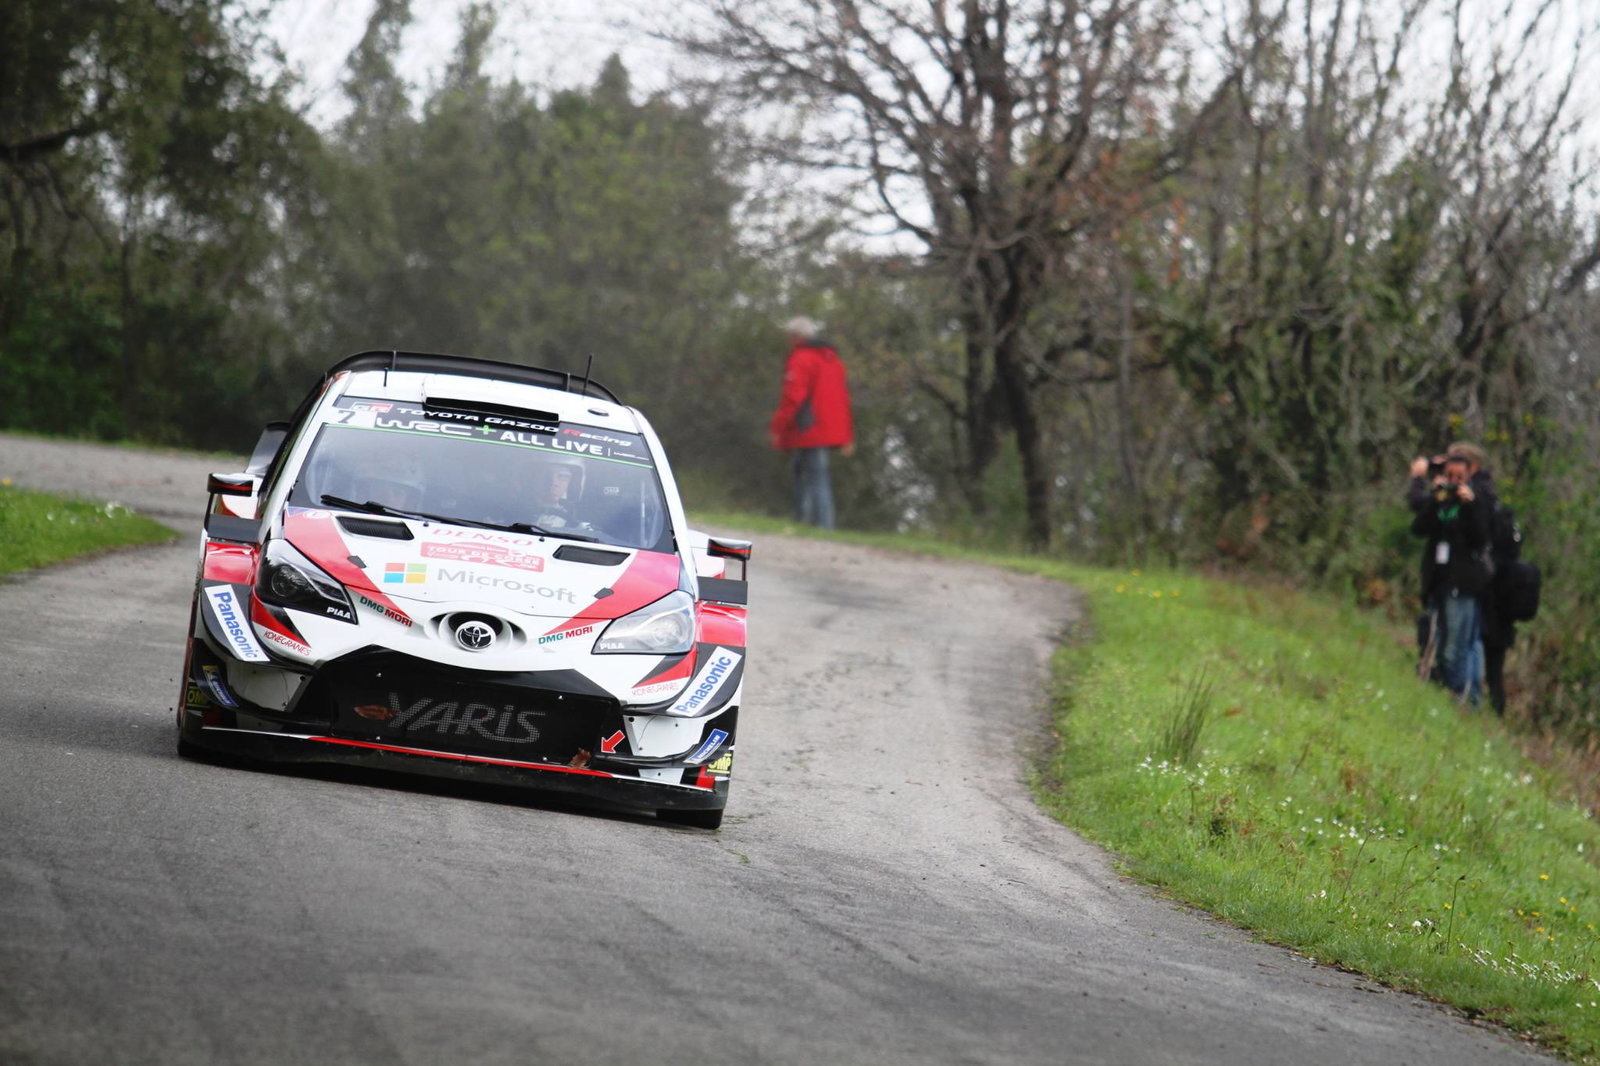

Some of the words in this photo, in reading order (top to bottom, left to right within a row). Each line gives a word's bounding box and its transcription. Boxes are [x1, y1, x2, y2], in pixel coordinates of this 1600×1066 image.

[338, 410, 357, 424] 7
[396, 407, 480, 422] TOYOTA
[484, 416, 559, 433] GAZOO
[563, 428, 632, 447] Racing
[500, 431, 545, 447] ALL
[551, 438, 603, 456] LIVE
[432, 528, 533, 547] DENSO
[427, 545, 467, 556] TOUR
[472, 550, 490, 559] DE
[436, 567, 577, 606] Microsoft
[326, 605, 352, 620] PIAA
[359, 595, 385, 614] DMG
[384, 609, 414, 628] MORI
[213, 591, 259, 659] Panasonic
[538, 632, 564, 645] DMG
[565, 625, 594, 640] MORI
[600, 641, 625, 651] PIAA
[675, 655, 732, 718] Panasonic
[698, 734, 721, 759] MICHELIN
